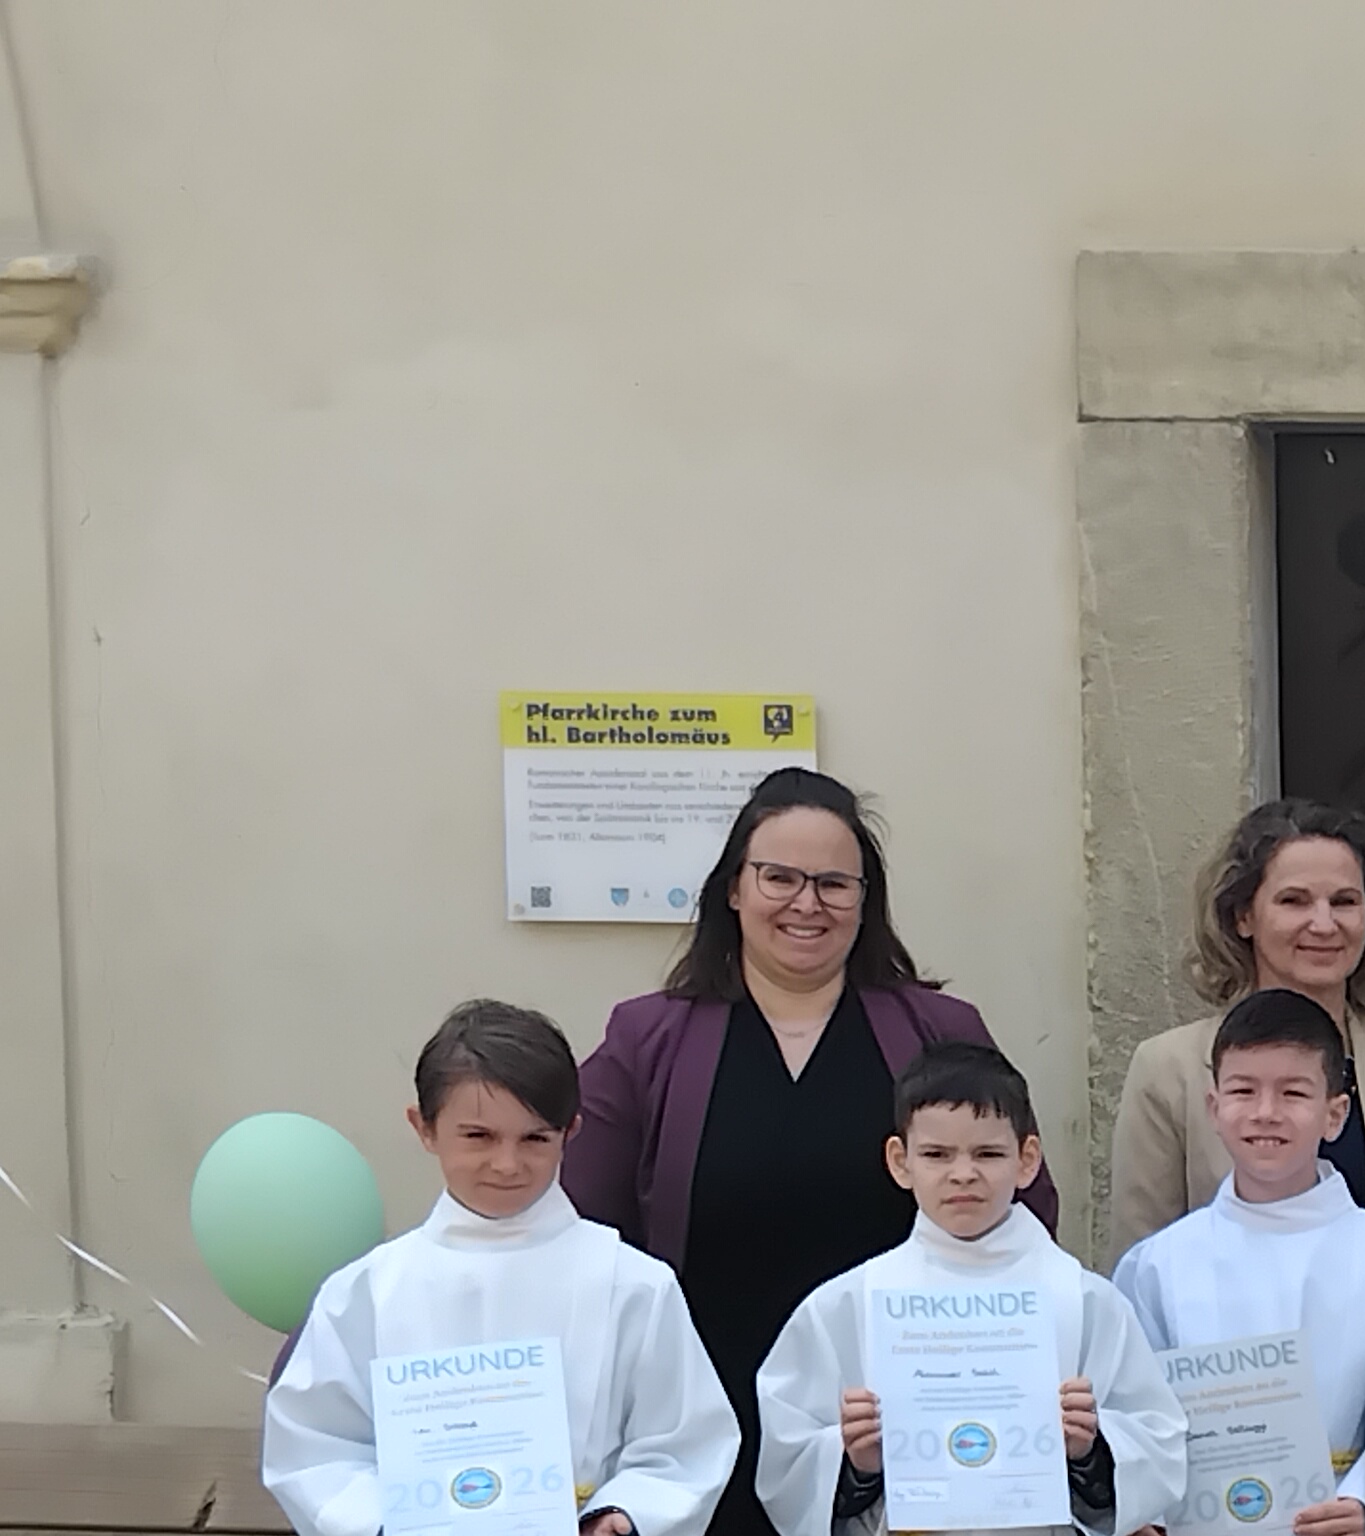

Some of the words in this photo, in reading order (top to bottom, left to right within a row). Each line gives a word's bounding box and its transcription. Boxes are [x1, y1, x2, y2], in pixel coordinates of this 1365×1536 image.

[526, 703, 660, 722] Pfarrkirche
[669, 708, 717, 722] zum
[526, 725, 557, 744] hl.
[567, 726, 731, 745] Bartholomäus
[886, 1291, 1039, 1319] URKUNDE
[386, 1345, 546, 1386] URKUNDE
